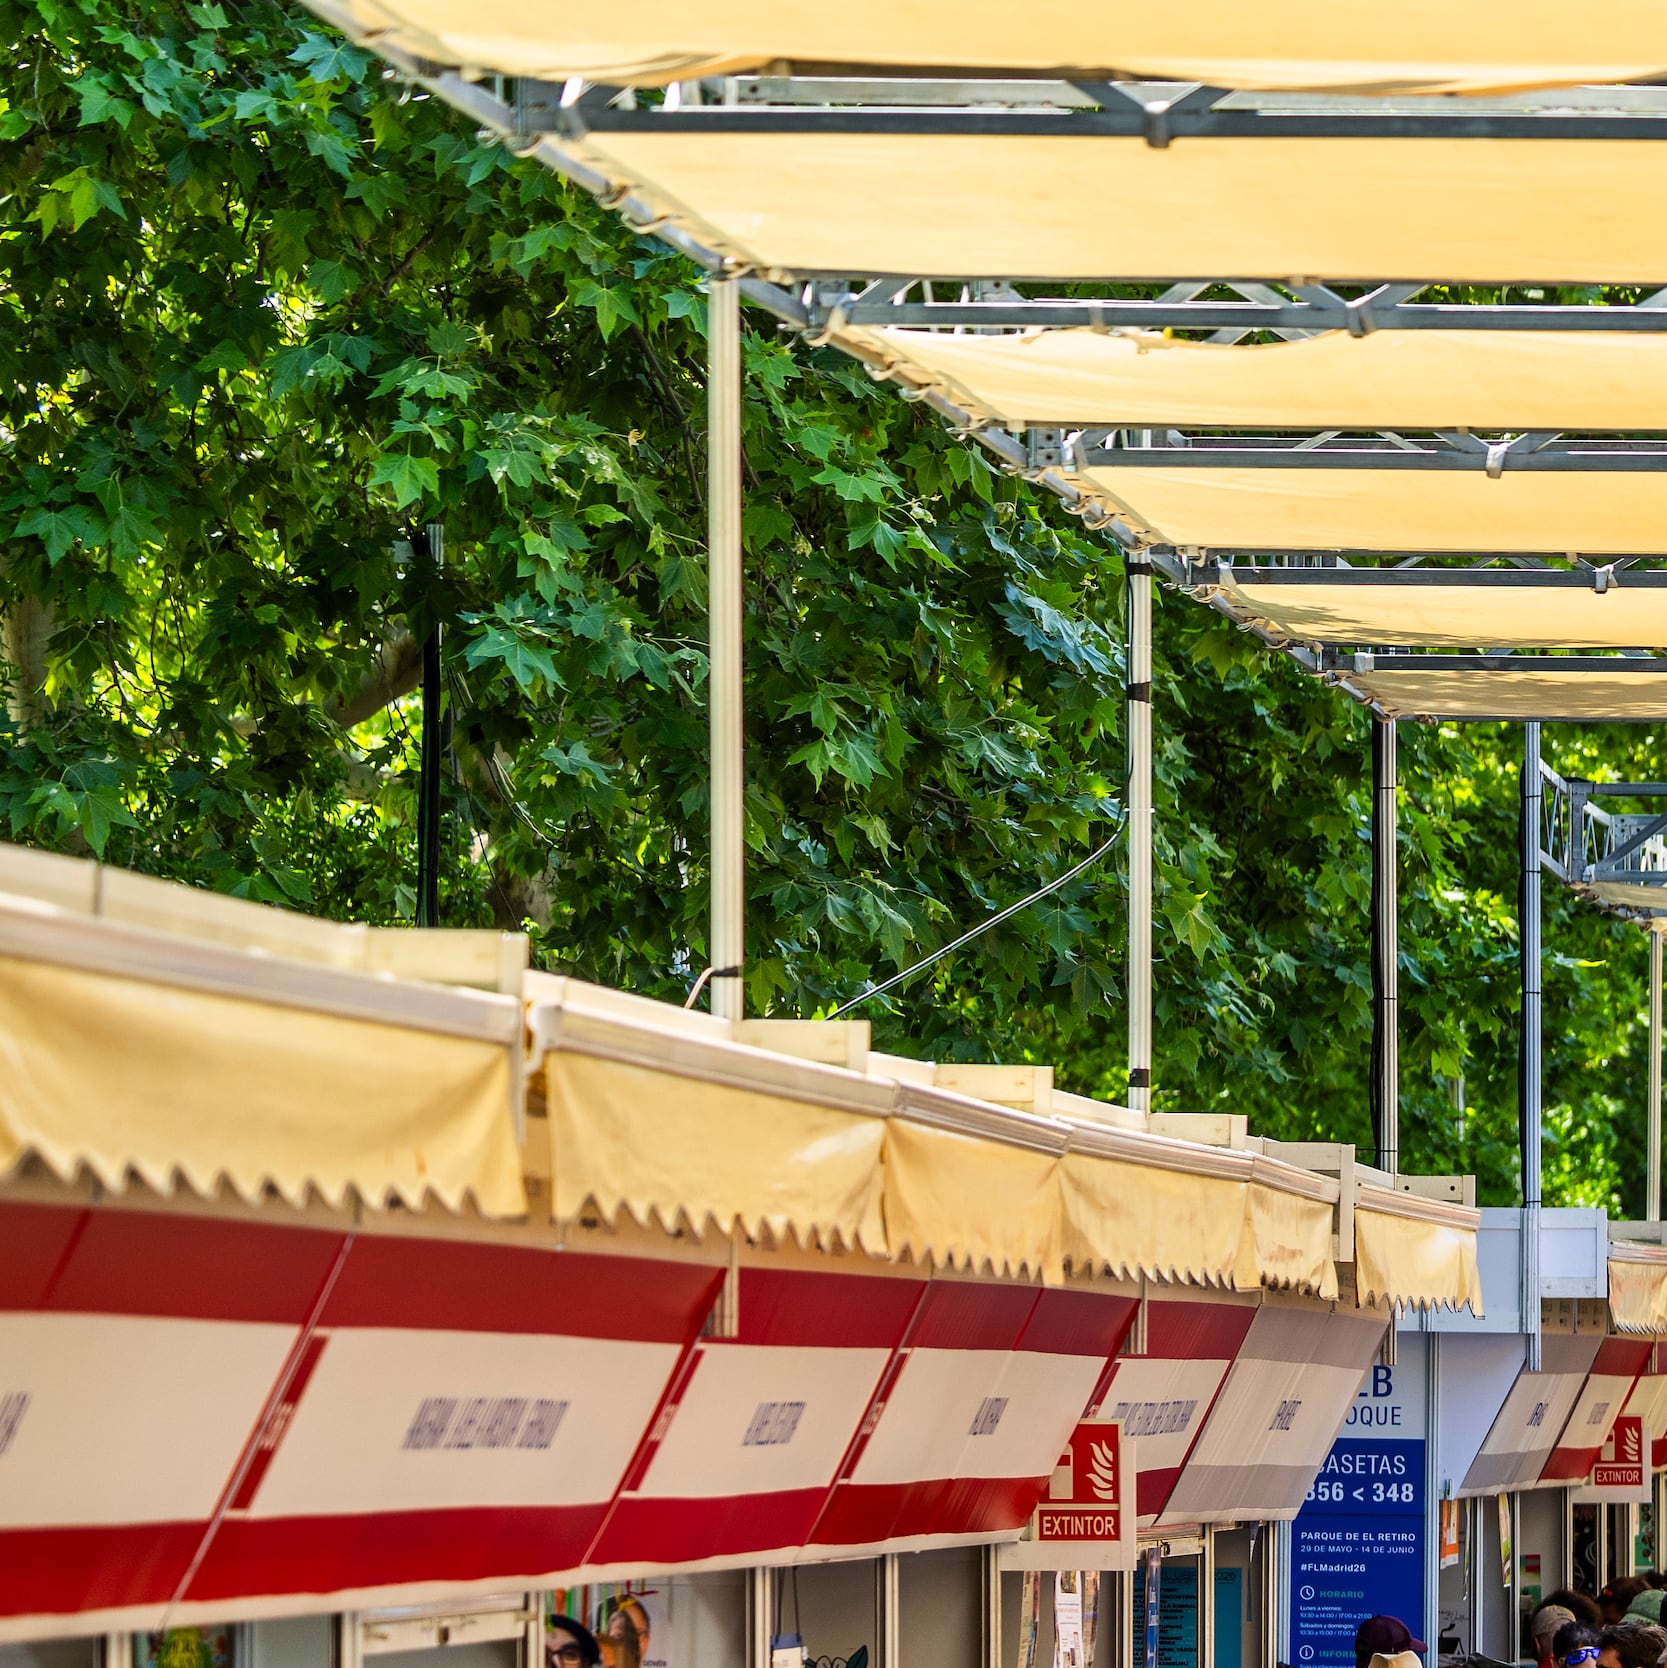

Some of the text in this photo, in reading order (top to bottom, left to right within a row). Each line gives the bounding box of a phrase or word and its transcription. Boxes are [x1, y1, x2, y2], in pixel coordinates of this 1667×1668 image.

[1358, 1366, 1393, 1397] B
[1596, 1470, 1640, 1483] EXTINTOR
[1372, 1483, 1414, 1502] 348
[1043, 1516, 1115, 1535] EXTINTOR
[1301, 1532, 1416, 1541] PARQUE DE EL RETIRO
[1328, 1545, 1353, 1553] MAYO
[1387, 1546, 1414, 1554] JUNIO
[1301, 1564, 1366, 1572] #FLMadrid26
[1320, 1590, 1364, 1599] HORARIO
